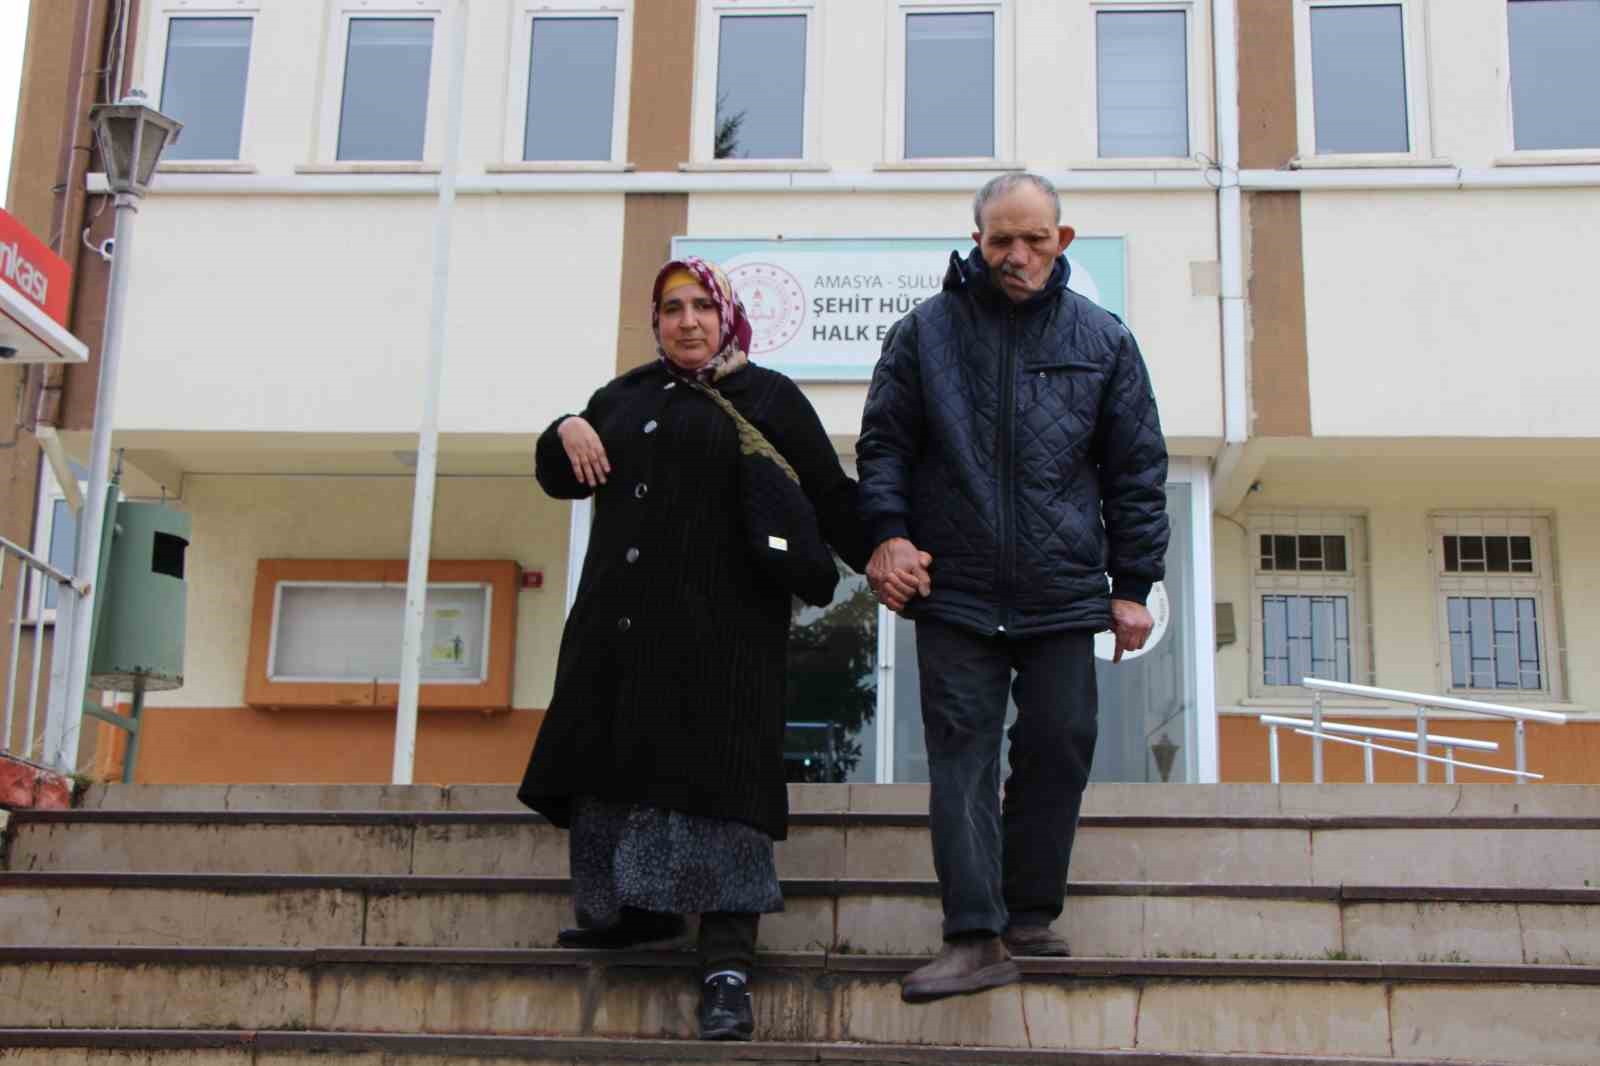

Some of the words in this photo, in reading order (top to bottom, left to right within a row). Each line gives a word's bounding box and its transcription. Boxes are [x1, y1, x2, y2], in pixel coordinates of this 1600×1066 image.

[814, 275, 883, 289] AMASYA
[813, 294, 873, 317] ŞEHİT
[812, 325, 869, 341] HALK
